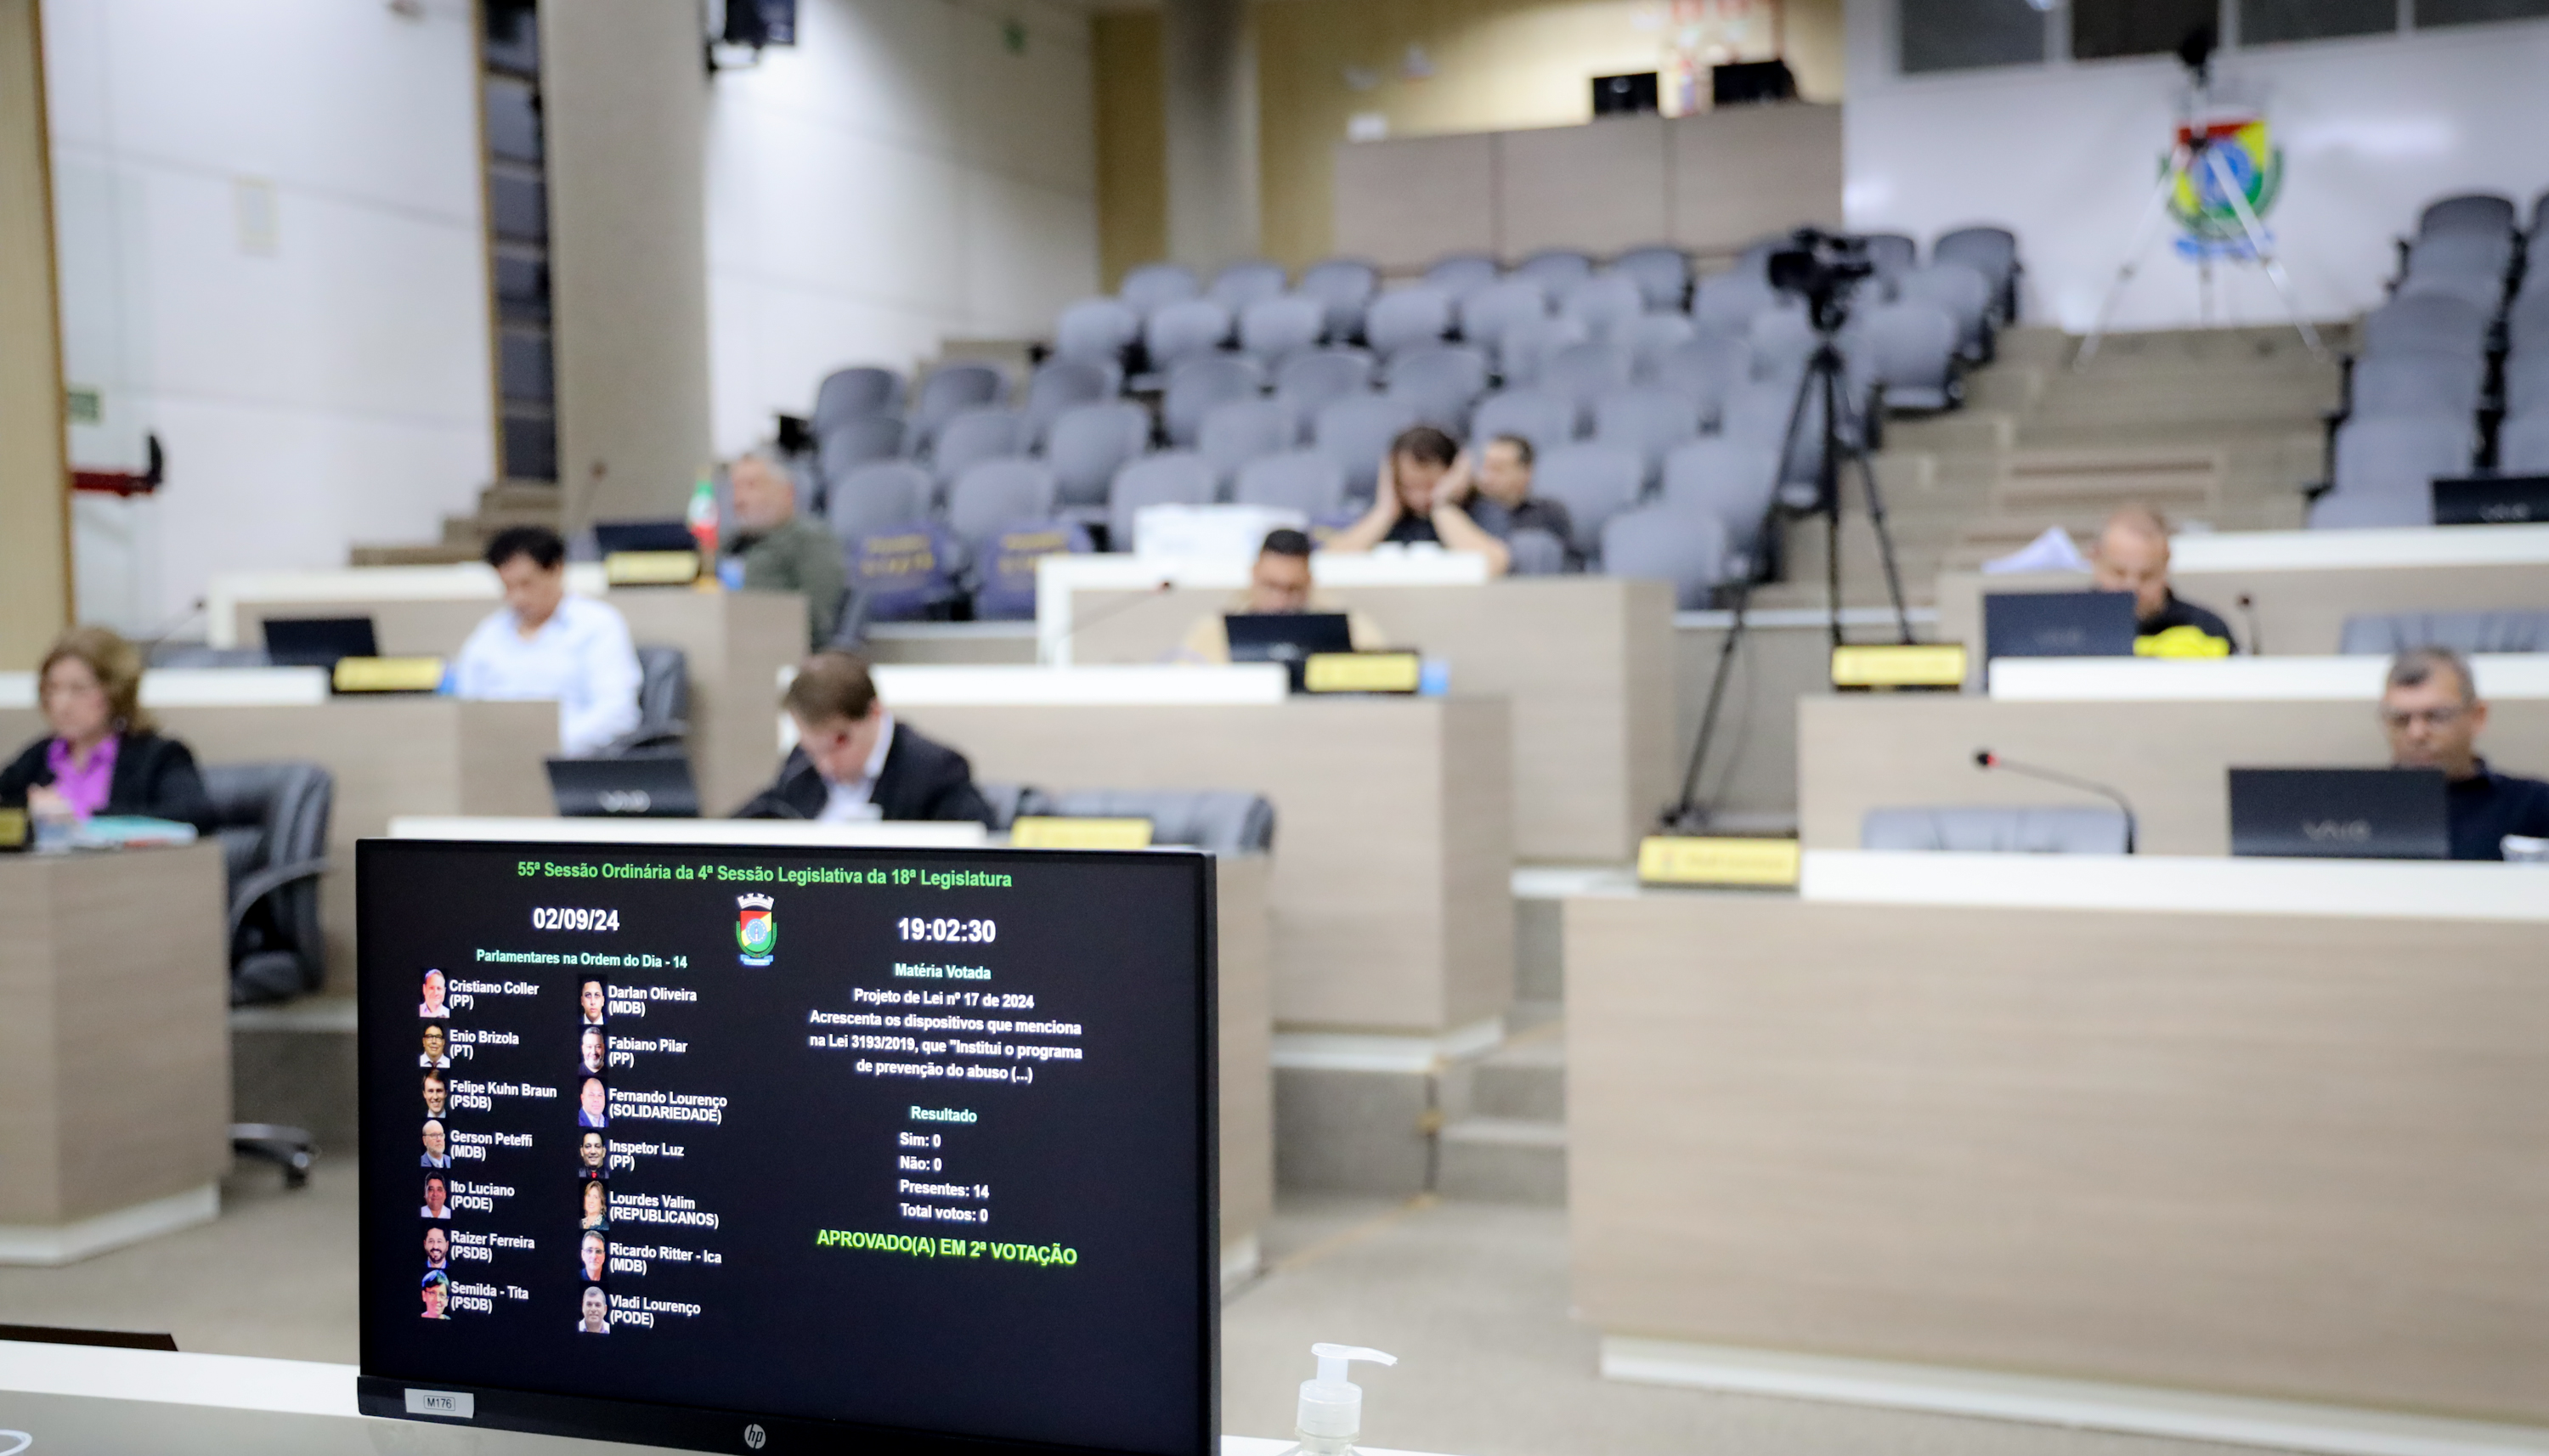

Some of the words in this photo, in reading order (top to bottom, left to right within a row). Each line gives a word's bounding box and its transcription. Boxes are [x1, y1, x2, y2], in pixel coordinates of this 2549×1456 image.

[544, 862, 598, 878] Sessão
[602, 863, 671, 880] Ordinária
[675, 865, 694, 880] da
[717, 865, 774, 882] Sessão
[778, 866, 862, 886] Legislativa
[867, 867, 887, 884] da
[920, 869, 1012, 889] Legislatura
[533, 907, 620, 931] 02/09/24
[898, 917, 997, 943] 19:02:30
[477, 947, 560, 966] Parlamentares
[562, 954, 578, 965] na
[580, 952, 621, 967] Ordem
[624, 953, 640, 968] do
[642, 954, 662, 968] Dia
[673, 955, 687, 968] 14
[895, 962, 943, 979] Matéria
[946, 964, 992, 980] Votada
[449, 979, 502, 994] Cristiano
[506, 981, 540, 996] Coller
[608, 985, 647, 1000] Darlan
[650, 986, 697, 1002] Oliveira
[449, 995, 474, 1010] (PP)
[854, 988, 901, 1007] Projeto
[904, 990, 920, 1004] de
[923, 990, 943, 1005] Lei
[964, 992, 979, 1007] 17
[982, 993, 1000, 1007] de
[1002, 994, 1035, 1008] 2024
[608, 1001, 646, 1017] (MDB)
[810, 1009, 882, 1026] Acrescenta
[885, 1014, 901, 1027] os
[904, 1014, 985, 1032] dispositivos
[986, 1019, 1013, 1034] que
[1015, 1019, 1082, 1036] menciona
[449, 1029, 477, 1043] Enio
[478, 1030, 519, 1045] Brizola
[608, 1036, 657, 1052] Fabiano
[659, 1038, 688, 1052] Pilar
[449, 1044, 473, 1060] (PT)
[810, 1035, 826, 1047] na
[828, 1033, 849, 1048] Lei
[851, 1035, 919, 1053] 3193/2019,
[922, 1039, 947, 1055] que
[949, 1039, 1002, 1056] "Institui
[1004, 1044, 1015, 1056] o
[1017, 1045, 1082, 1061] programa
[608, 1052, 635, 1068] (PP)
[856, 1058, 873, 1073] de
[876, 1060, 944, 1078] prevenção
[947, 1063, 964, 1077] do
[967, 1064, 1009, 1080] abuso
[1011, 1066, 1033, 1083] (...)
[450, 1080, 484, 1097] Felipe
[488, 1081, 519, 1096] Kuhn
[521, 1083, 557, 1098] Braun
[608, 1087, 667, 1104] Fernando
[669, 1091, 727, 1109] Lourenço
[450, 1095, 492, 1112] (PSDB)
[608, 1103, 722, 1125] (SOLIDARIEDADE)
[911, 1105, 978, 1122] Resultado
[450, 1130, 493, 1145] Gerson
[495, 1132, 533, 1147] Peteffi
[900, 1132, 930, 1147] Sim:
[933, 1133, 941, 1148] 0
[450, 1145, 486, 1161] (MDB)
[609, 1139, 659, 1157] Inspetor
[662, 1143, 685, 1157] Luz
[609, 1155, 636, 1171] (PP)
[900, 1155, 930, 1171] Não:
[933, 1157, 942, 1171] 0
[450, 1180, 466, 1194] Ito
[468, 1181, 515, 1197] Luciano
[900, 1179, 970, 1197] Presentes:
[973, 1184, 990, 1199] 14
[450, 1194, 494, 1212] (PODE)
[609, 1191, 659, 1208] Lourdes
[661, 1194, 696, 1210] Valim
[609, 1206, 719, 1229] (REPUBLICANOS)
[901, 1202, 932, 1218] Total
[935, 1205, 976, 1222] votos:
[980, 1208, 989, 1222] 0
[450, 1230, 487, 1245] Raizer
[489, 1233, 535, 1250] Ferreira
[817, 1228, 935, 1258] APROVADO(A)
[941, 1239, 966, 1256] EM
[991, 1241, 1077, 1266] VOTAÇÃO
[450, 1246, 493, 1264] (PSDB)
[609, 1242, 657, 1260] Ricardo
[659, 1245, 693, 1262] Ritter
[704, 1249, 722, 1264] Ica
[609, 1258, 647, 1276] (MDB)
[450, 1280, 497, 1298] Semilda
[507, 1284, 528, 1300] Tita
[450, 1296, 493, 1314] (PSDB)
[609, 1293, 640, 1311] Vladi
[642, 1296, 701, 1317] Lourenço
[609, 1310, 654, 1329] (PODE)
[427, 1397, 452, 1409] M176
[748, 1424, 764, 1448] hp
